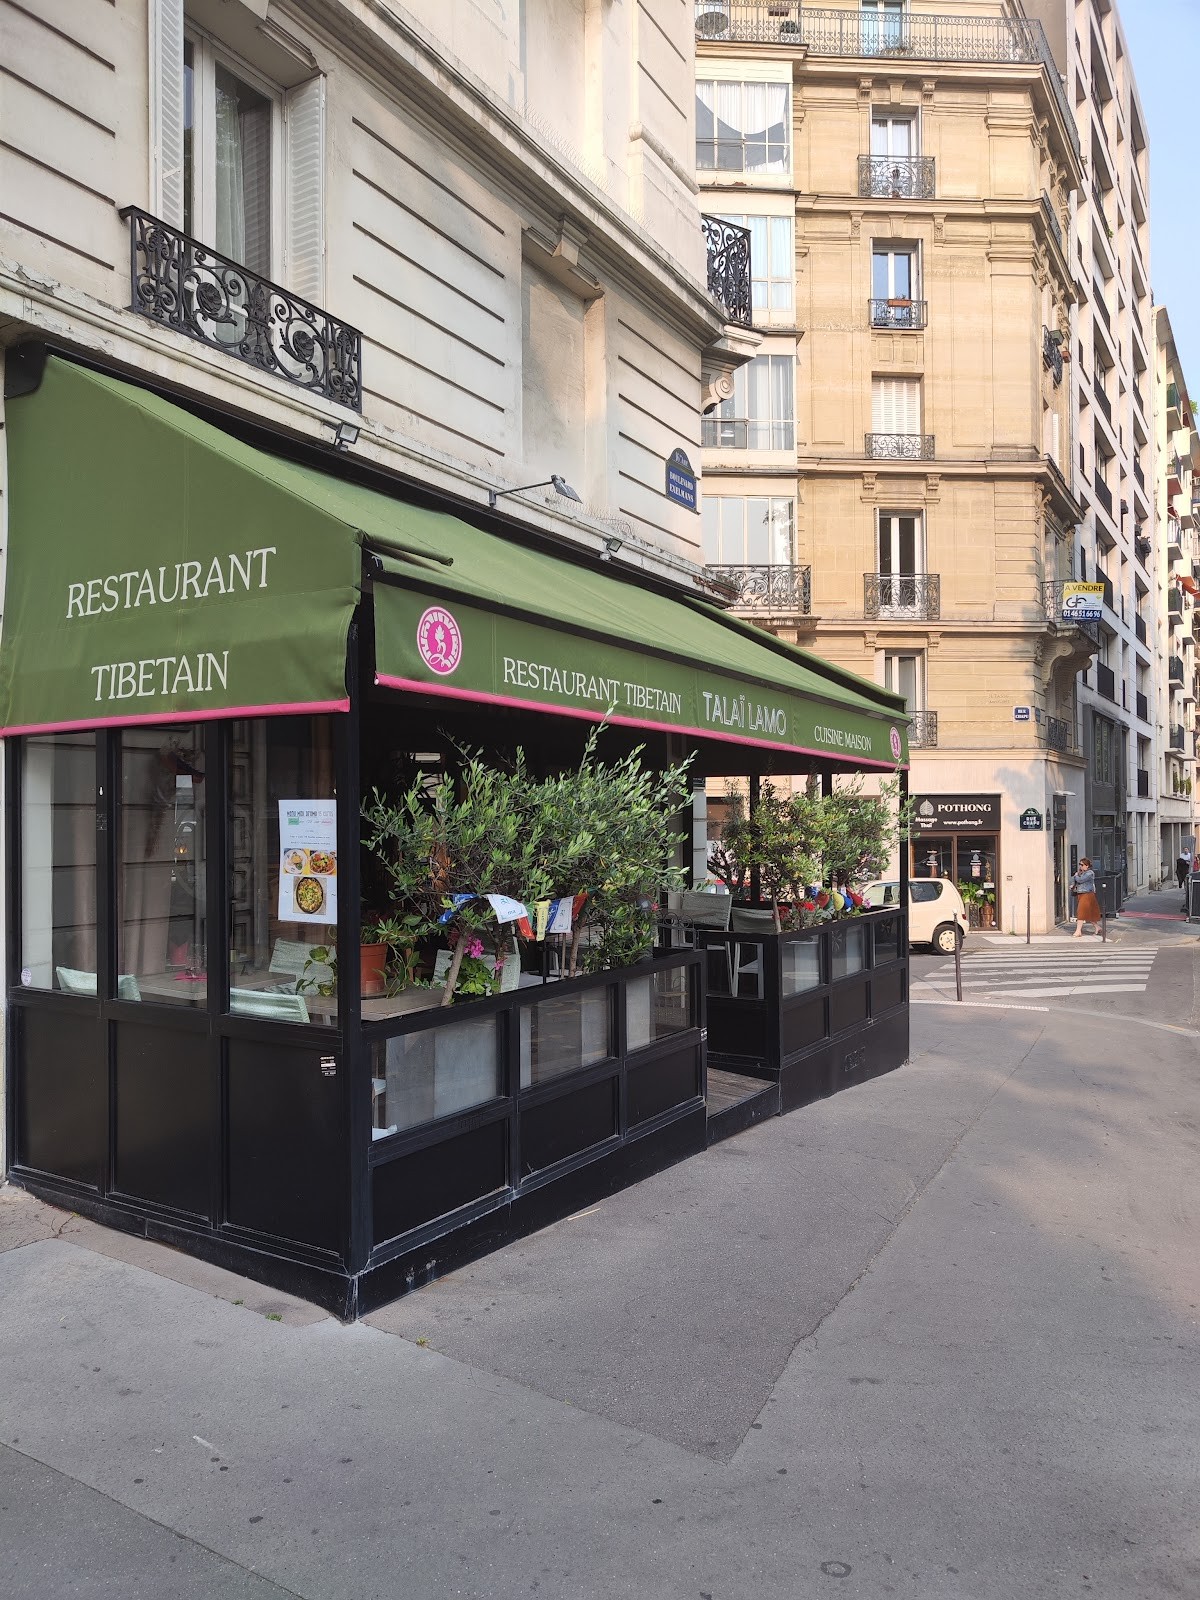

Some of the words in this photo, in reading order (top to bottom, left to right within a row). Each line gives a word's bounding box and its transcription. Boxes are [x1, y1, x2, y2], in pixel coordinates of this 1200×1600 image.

[670, 471, 694, 490] BOULEVARD
[670, 484, 694, 502] EXELMANS
[66, 547, 276, 618] RESTAURANT
[91, 651, 229, 701] TIBETAIN
[503, 657, 620, 702] RESTAURANT
[624, 682, 681, 715] TIBETAIN
[702, 691, 745, 728] TALAÏ
[748, 702, 787, 736] LAMO
[814, 725, 843, 746] CUISINE
[844, 732, 872, 752] MAISON
[938, 804, 992, 812] POTHONG
[915, 816, 938, 824] Massage
